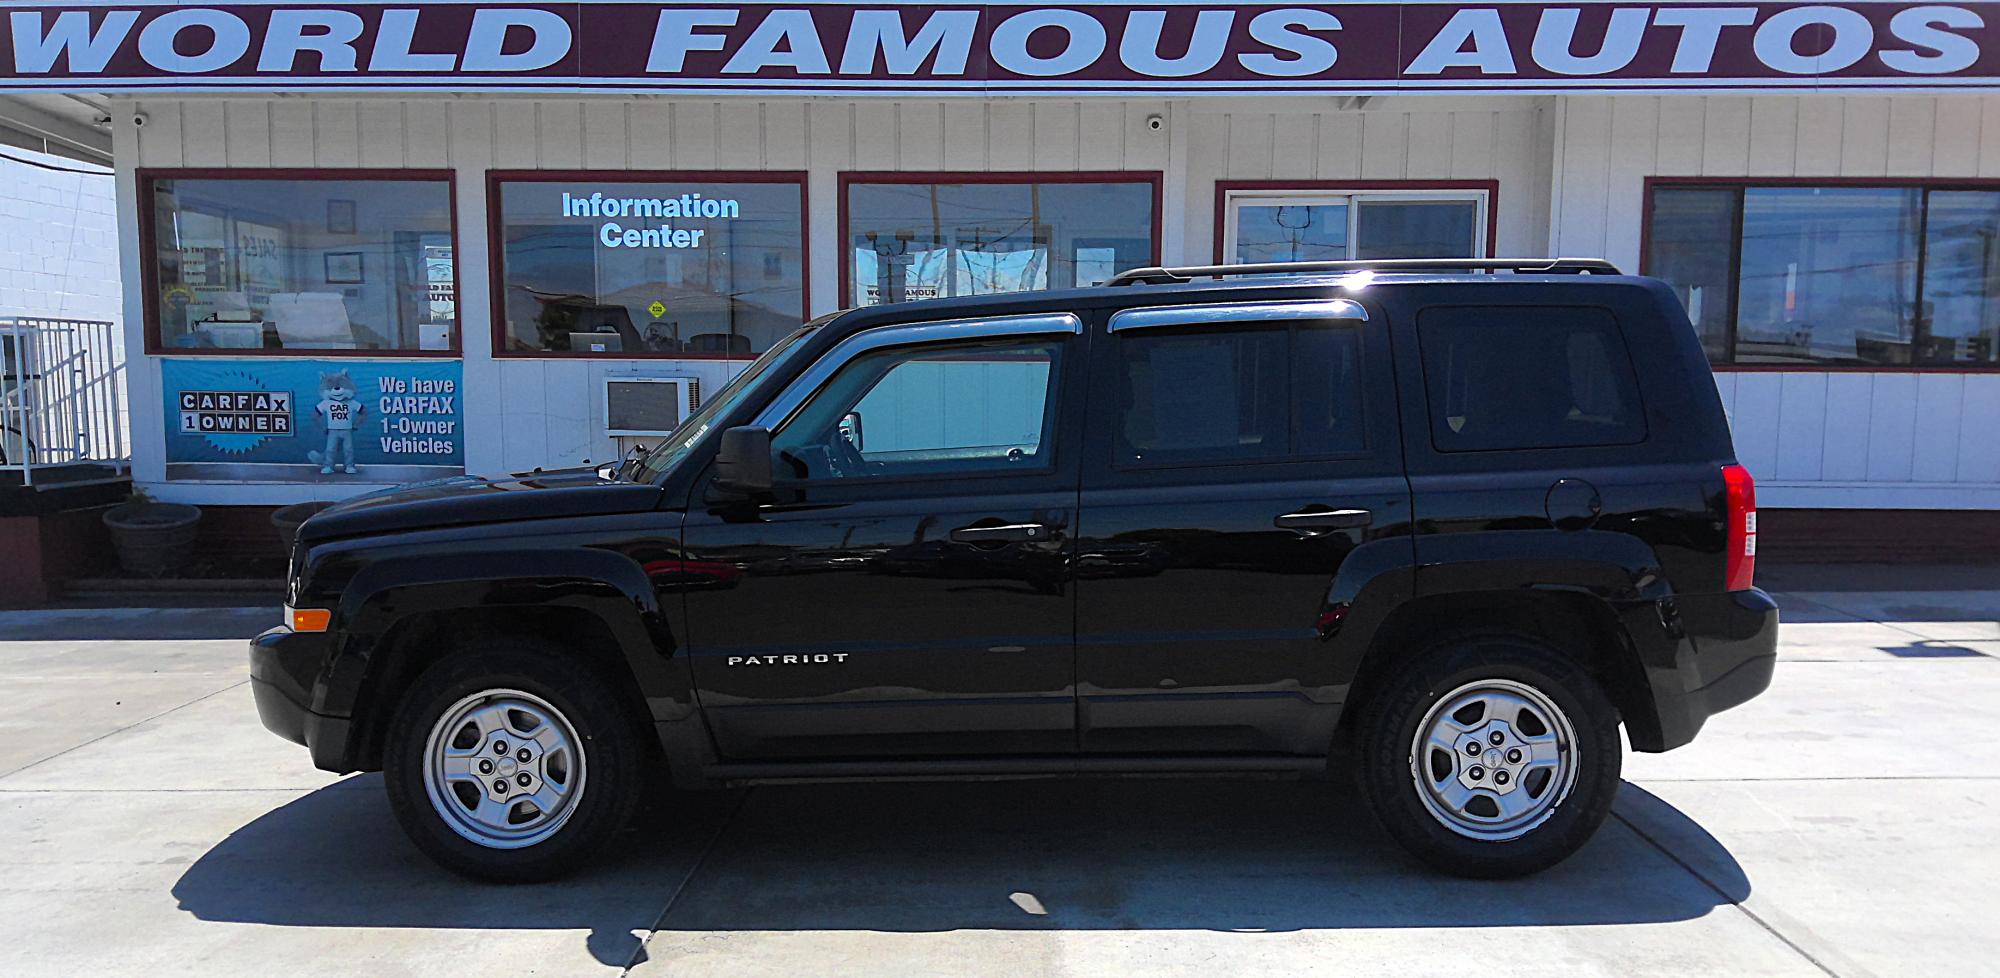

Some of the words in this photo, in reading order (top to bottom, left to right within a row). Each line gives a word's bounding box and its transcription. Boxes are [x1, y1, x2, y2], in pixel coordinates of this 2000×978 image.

[9, 8, 572, 73] WORLD
[645, 8, 1343, 77] FAMOUS
[1403, 5, 1985, 75] AUTOS
[562, 192, 739, 218] Information
[600, 222, 705, 248] Center
[905, 289, 936, 297] AMOUS
[379, 376, 406, 393] We
[411, 376, 455, 394] have
[183, 394, 286, 412] CARFAX
[329, 404, 349, 412] CAR
[380, 396, 454, 414] CARFAX
[185, 415, 196, 430] 1
[202, 416, 287, 430] OWNER
[331, 412, 349, 421] FOX
[380, 417, 455, 434] 1-Owner
[380, 436, 454, 454] Vehicles
[728, 653, 849, 666] PATRIOT
